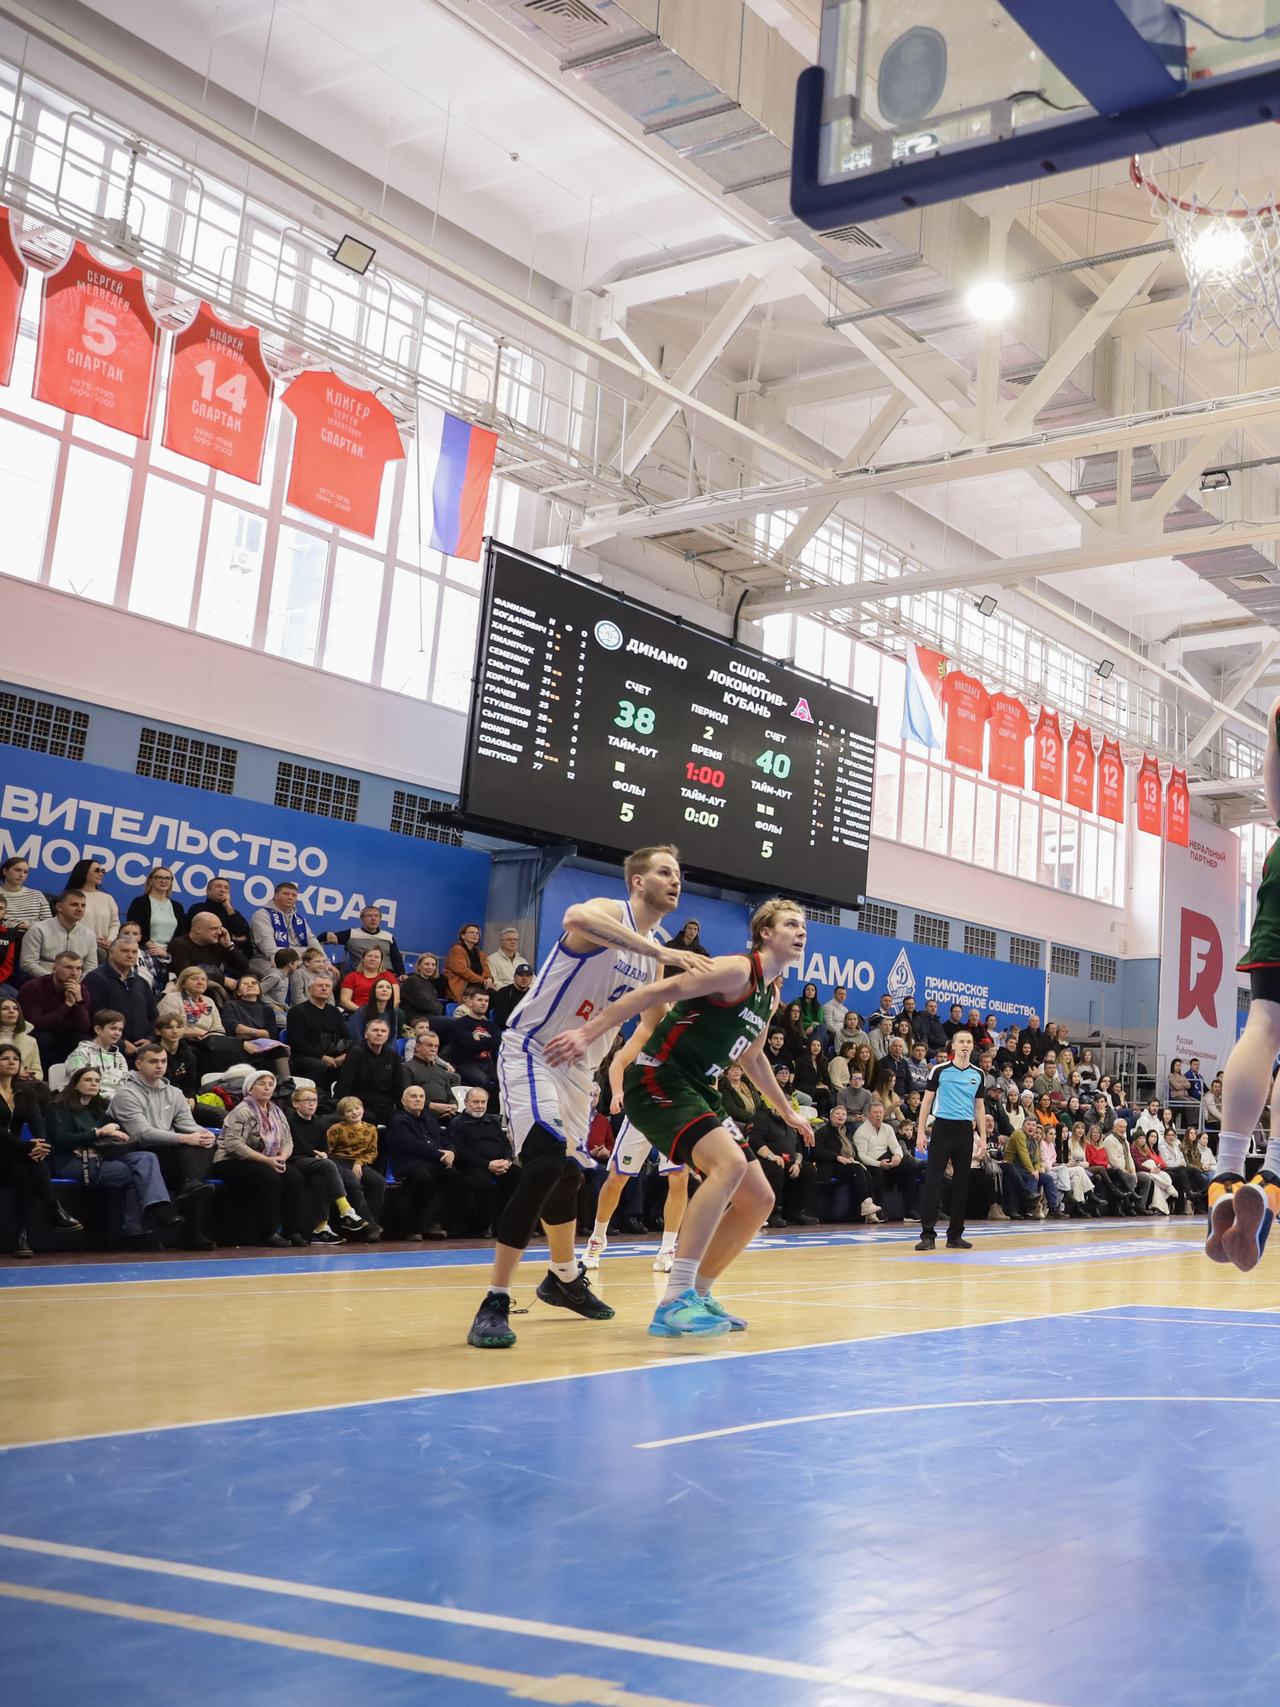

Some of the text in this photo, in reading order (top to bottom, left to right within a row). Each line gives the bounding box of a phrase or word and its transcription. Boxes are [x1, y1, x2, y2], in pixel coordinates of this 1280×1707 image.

[87, 270, 124, 295] СЕРГЕЙ
[81, 304, 117, 356] 5
[210, 328, 244, 352] АНДРЕЙ
[67, 348, 124, 383] СПАРТАК
[194, 359, 247, 415] 14
[326, 387, 371, 419] КЛИГЕР
[192, 400, 243, 433] СПАРТАК
[333, 409, 358, 427] СЕРГЕЙ
[321, 428, 364, 458] СПАРТАК
[494, 598, 536, 618] ФАМИЛИЯ
[491, 620, 525, 638] ХАРРИС
[492, 608, 547, 634] БОГДАНОВИЧ
[580, 641, 587, 649] 2
[490, 633, 535, 655] ПИЛИПЧУК
[626, 638, 688, 670] ДИНАМО
[489, 646, 531, 666] СЕМЕНЮК
[543, 665, 552, 673] 15
[486, 671, 530, 691] КОРЧАГИН
[540, 689, 551, 697] 24
[487, 658, 582, 696] СМЫГИН 21 2
[729, 661, 770, 684] СШОР-
[484, 683, 517, 699] ГРАЧЕВ
[539, 701, 549, 709] 25
[625, 680, 651, 696] СЧЕТ
[707, 669, 787, 707] ЛОКОМОТИВ-
[483, 696, 532, 717] СТУЛЕНКОВ
[537, 713, 548, 722] 26
[614, 700, 656, 734] 38
[691, 703, 729, 725] ПЕРИОД
[723, 692, 772, 719] КУБАНЬ
[480, 721, 511, 736] ИОНОВ
[535, 738, 546, 746] 36
[482, 709, 529, 728] СЫТНИКОВ
[536, 725, 547, 734] 29
[703, 726, 714, 740] 2
[479, 734, 523, 752] СОЛОВЬЕВ
[534, 750, 544, 759] 41
[607, 735, 658, 759] ТАЙМ-АУТ
[764, 730, 787, 743] СЧЕТ
[691, 744, 723, 761] ВРЕМЯ
[1040, 736, 1056, 763] 12
[1076, 750, 1086, 774] 7
[478, 746, 575, 780] МИТУСОВ 77 12
[685, 762, 726, 788] 1:00
[755, 750, 791, 779] 40
[612, 780, 646, 797] ФОЛЫ
[1103, 763, 1118, 789] 12
[680, 787, 726, 808] ТАЙМ-АУТ
[751, 780, 792, 800] ТАЙМ-АУТ
[1144, 780, 1157, 803] 13
[619, 802, 635, 822] 5
[1172, 792, 1185, 815] 14
[684, 807, 719, 828] 0:00
[755, 820, 782, 835] ФОЛЫ
[760, 840, 773, 858] 5
[1189, 839, 1226, 862] НЕРАЛЬНЫЙ
[1190, 851, 1218, 869] ПАРТНЕР
[294, 882, 397, 928] КРАЯ
[782, 950, 875, 992] НАМО
[925, 976, 989, 997] ПРИМОРСКОЕ
[924, 989, 987, 1011] СПОРТИВНОЕ
[988, 999, 1036, 1018] ОБЩЕСТВО
